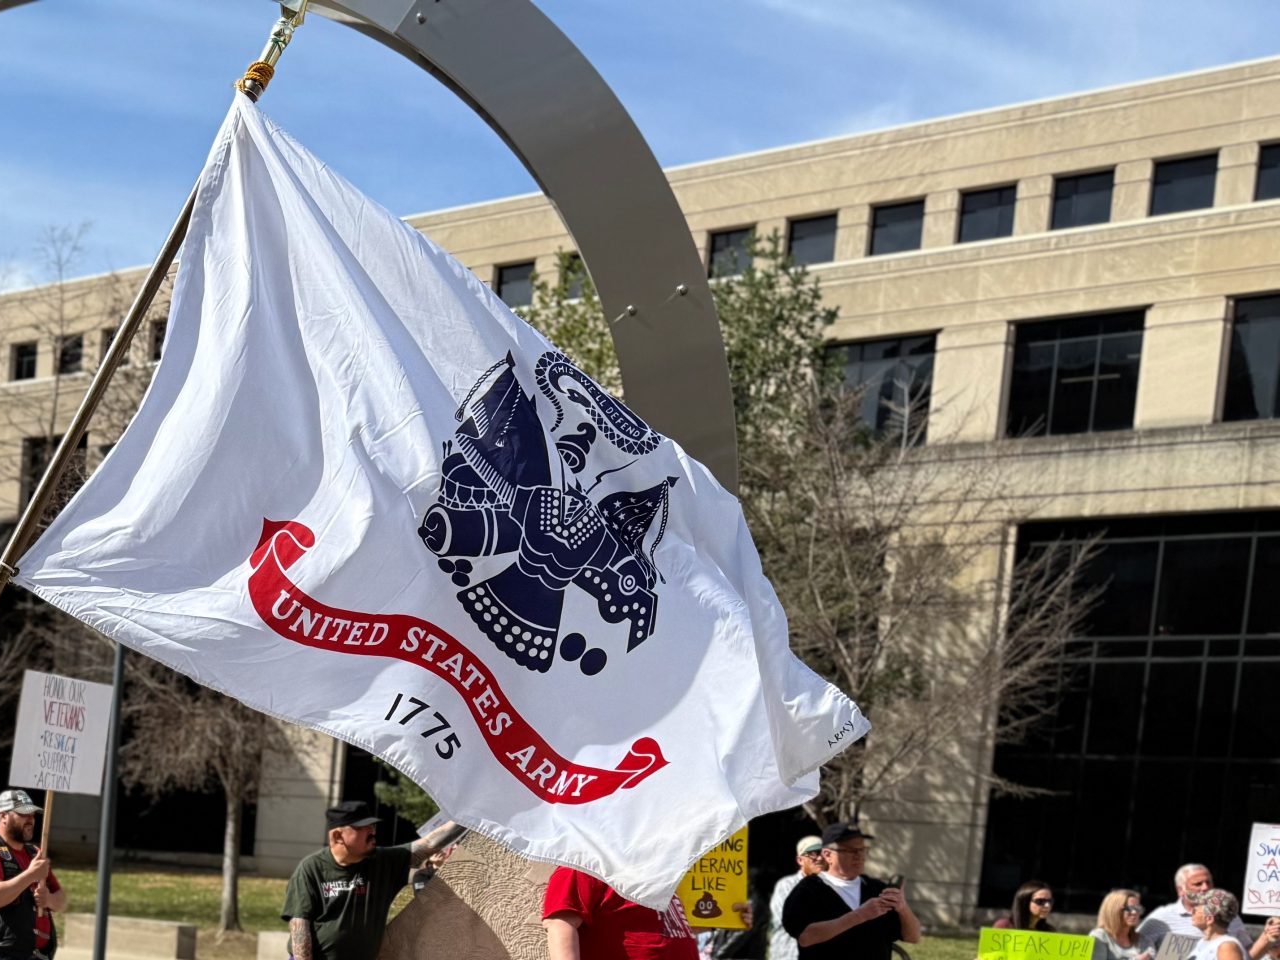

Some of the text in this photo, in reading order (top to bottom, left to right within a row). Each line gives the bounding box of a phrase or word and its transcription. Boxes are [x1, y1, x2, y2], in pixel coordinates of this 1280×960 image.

[552, 366, 641, 437] THIS WE'LL DEFEND
[271, 589, 598, 797] UNITED STATES ARMY
[384, 693, 462, 760] 1775
[827, 720, 855, 748] ARMY
[691, 876, 727, 891] LIKE
[990, 932, 1050, 956] SPEAK
